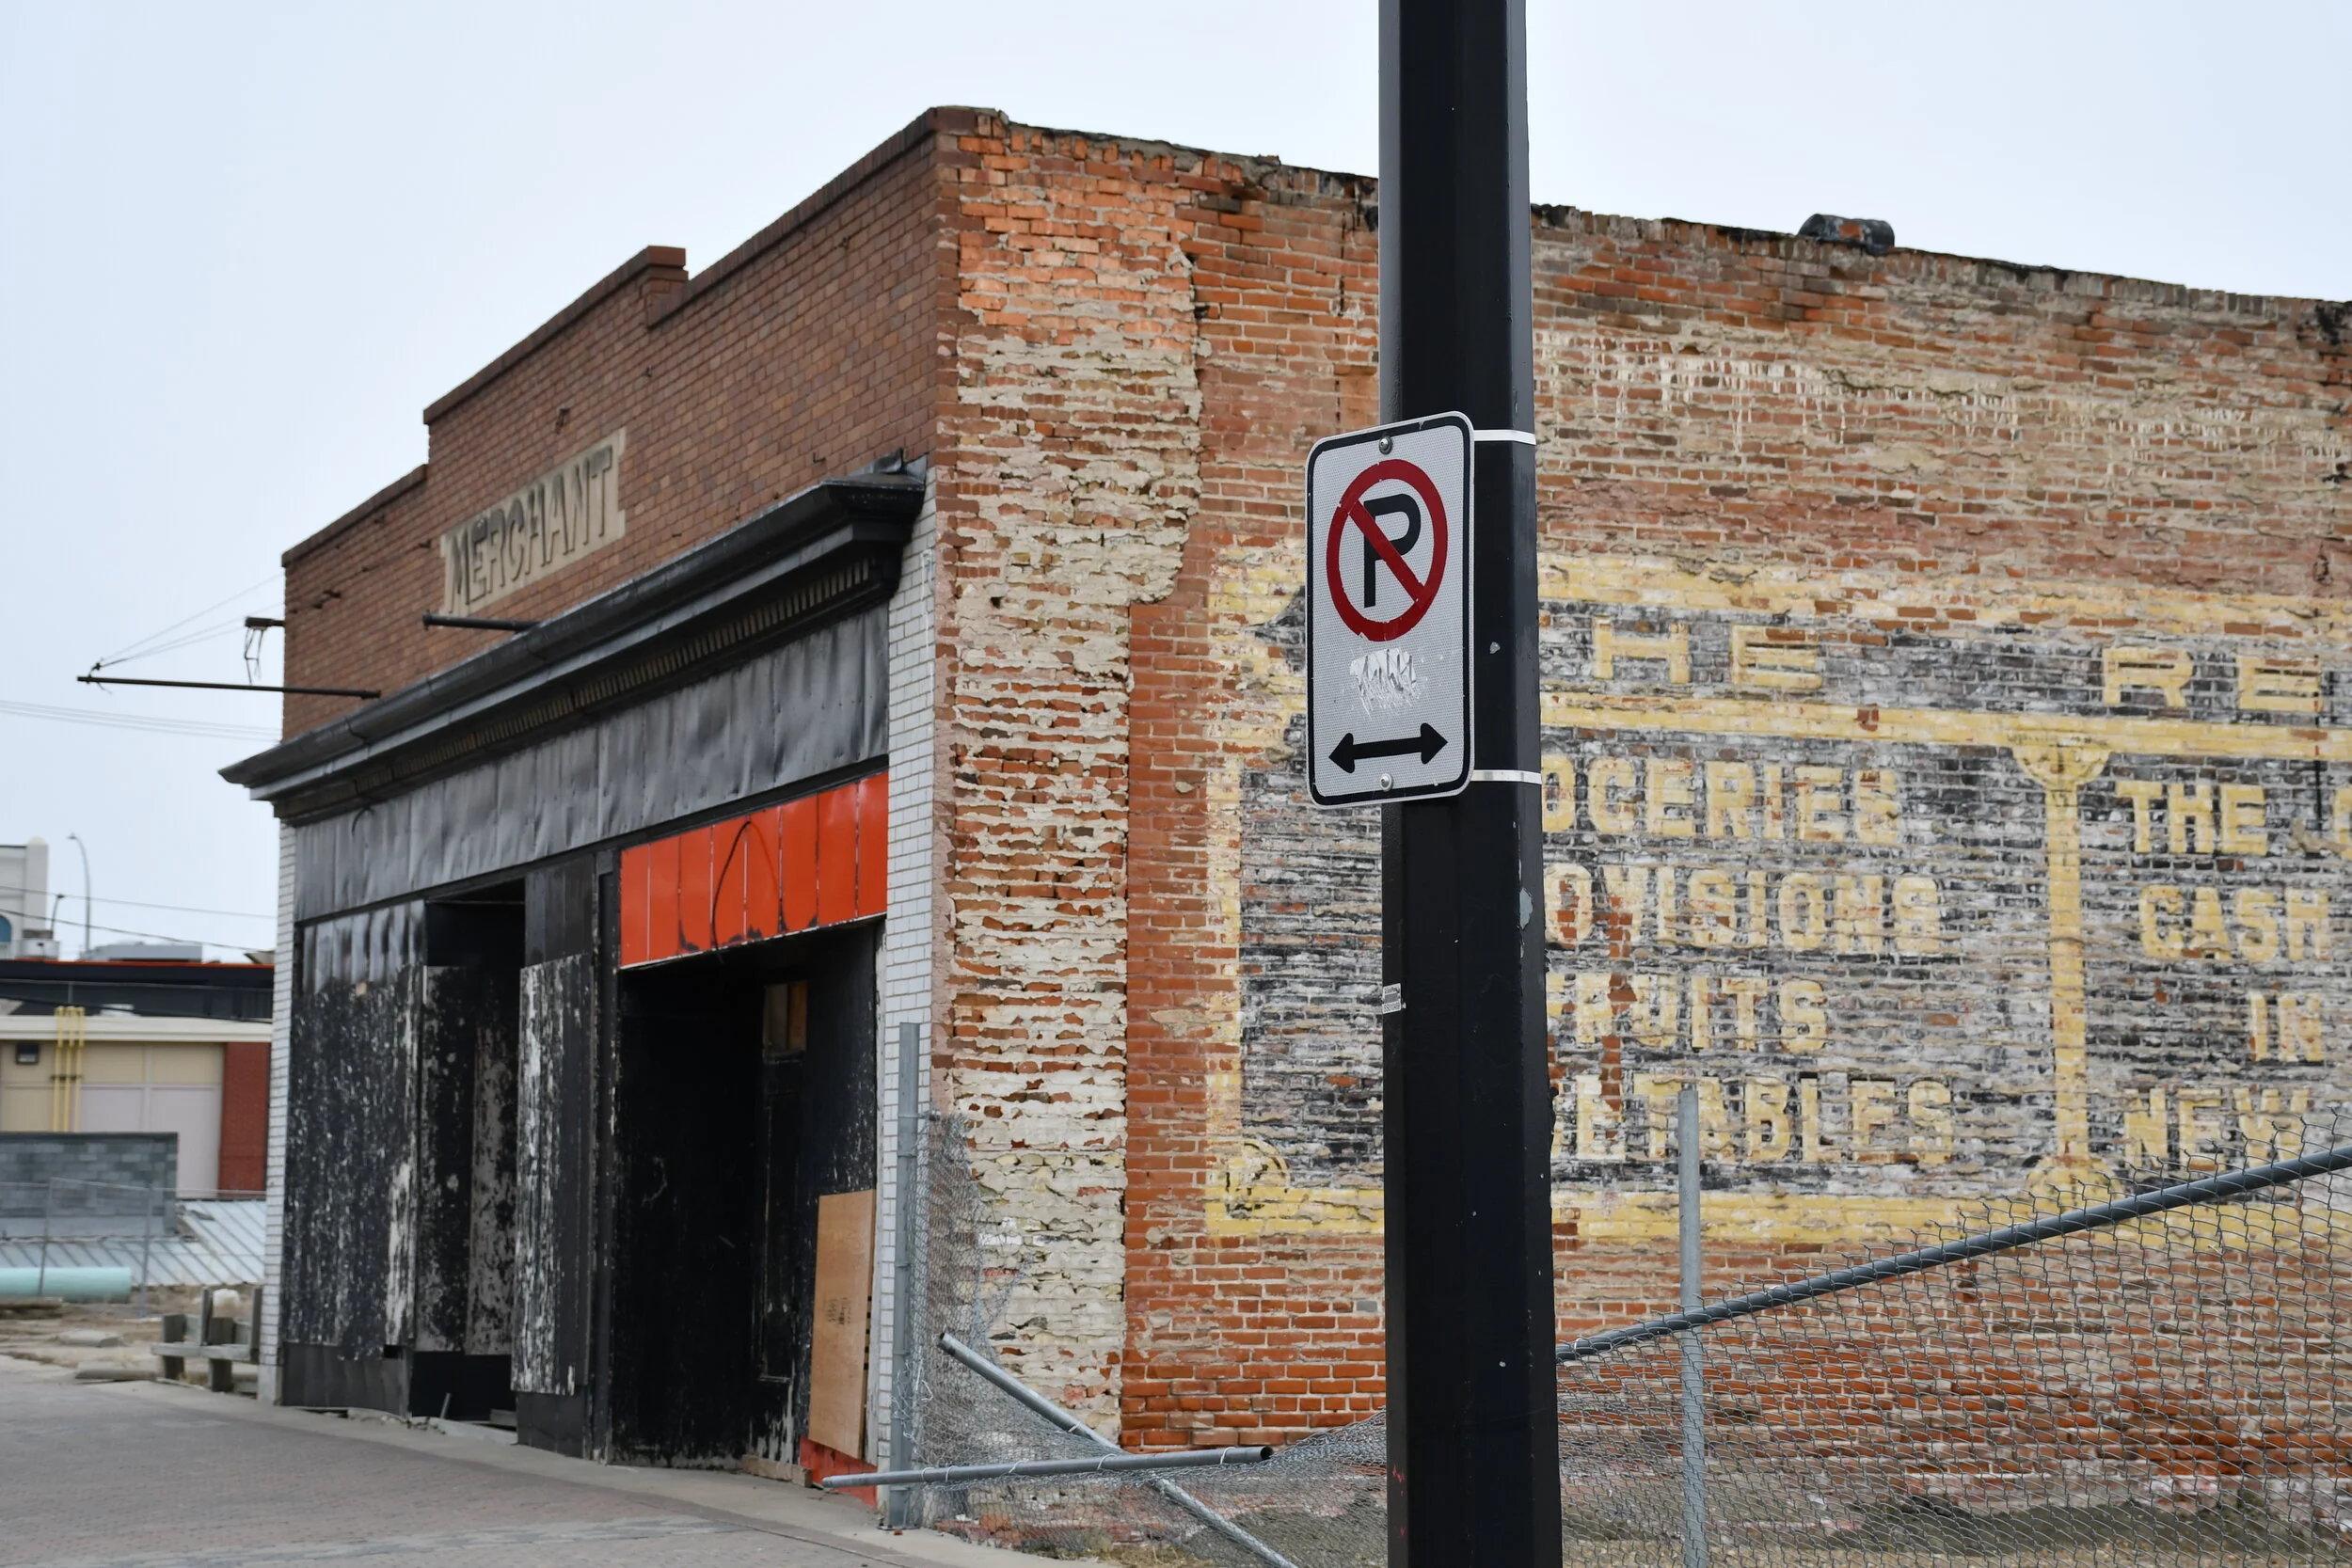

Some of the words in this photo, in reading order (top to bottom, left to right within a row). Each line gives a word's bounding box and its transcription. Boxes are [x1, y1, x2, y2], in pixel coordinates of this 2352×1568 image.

[447, 445, 613, 615] MERCHANT
[1363, 494, 1422, 608] P
[1539, 615, 1822, 689] HE
[1541, 752, 1900, 843] OCERIES
[2116, 781, 2268, 855] THE
[1543, 863, 1942, 953] OVISIONS
[2139, 885, 2329, 961] CASH
[2249, 991, 2324, 1062] IN
[1551, 1073, 1953, 1164] ETABLES
